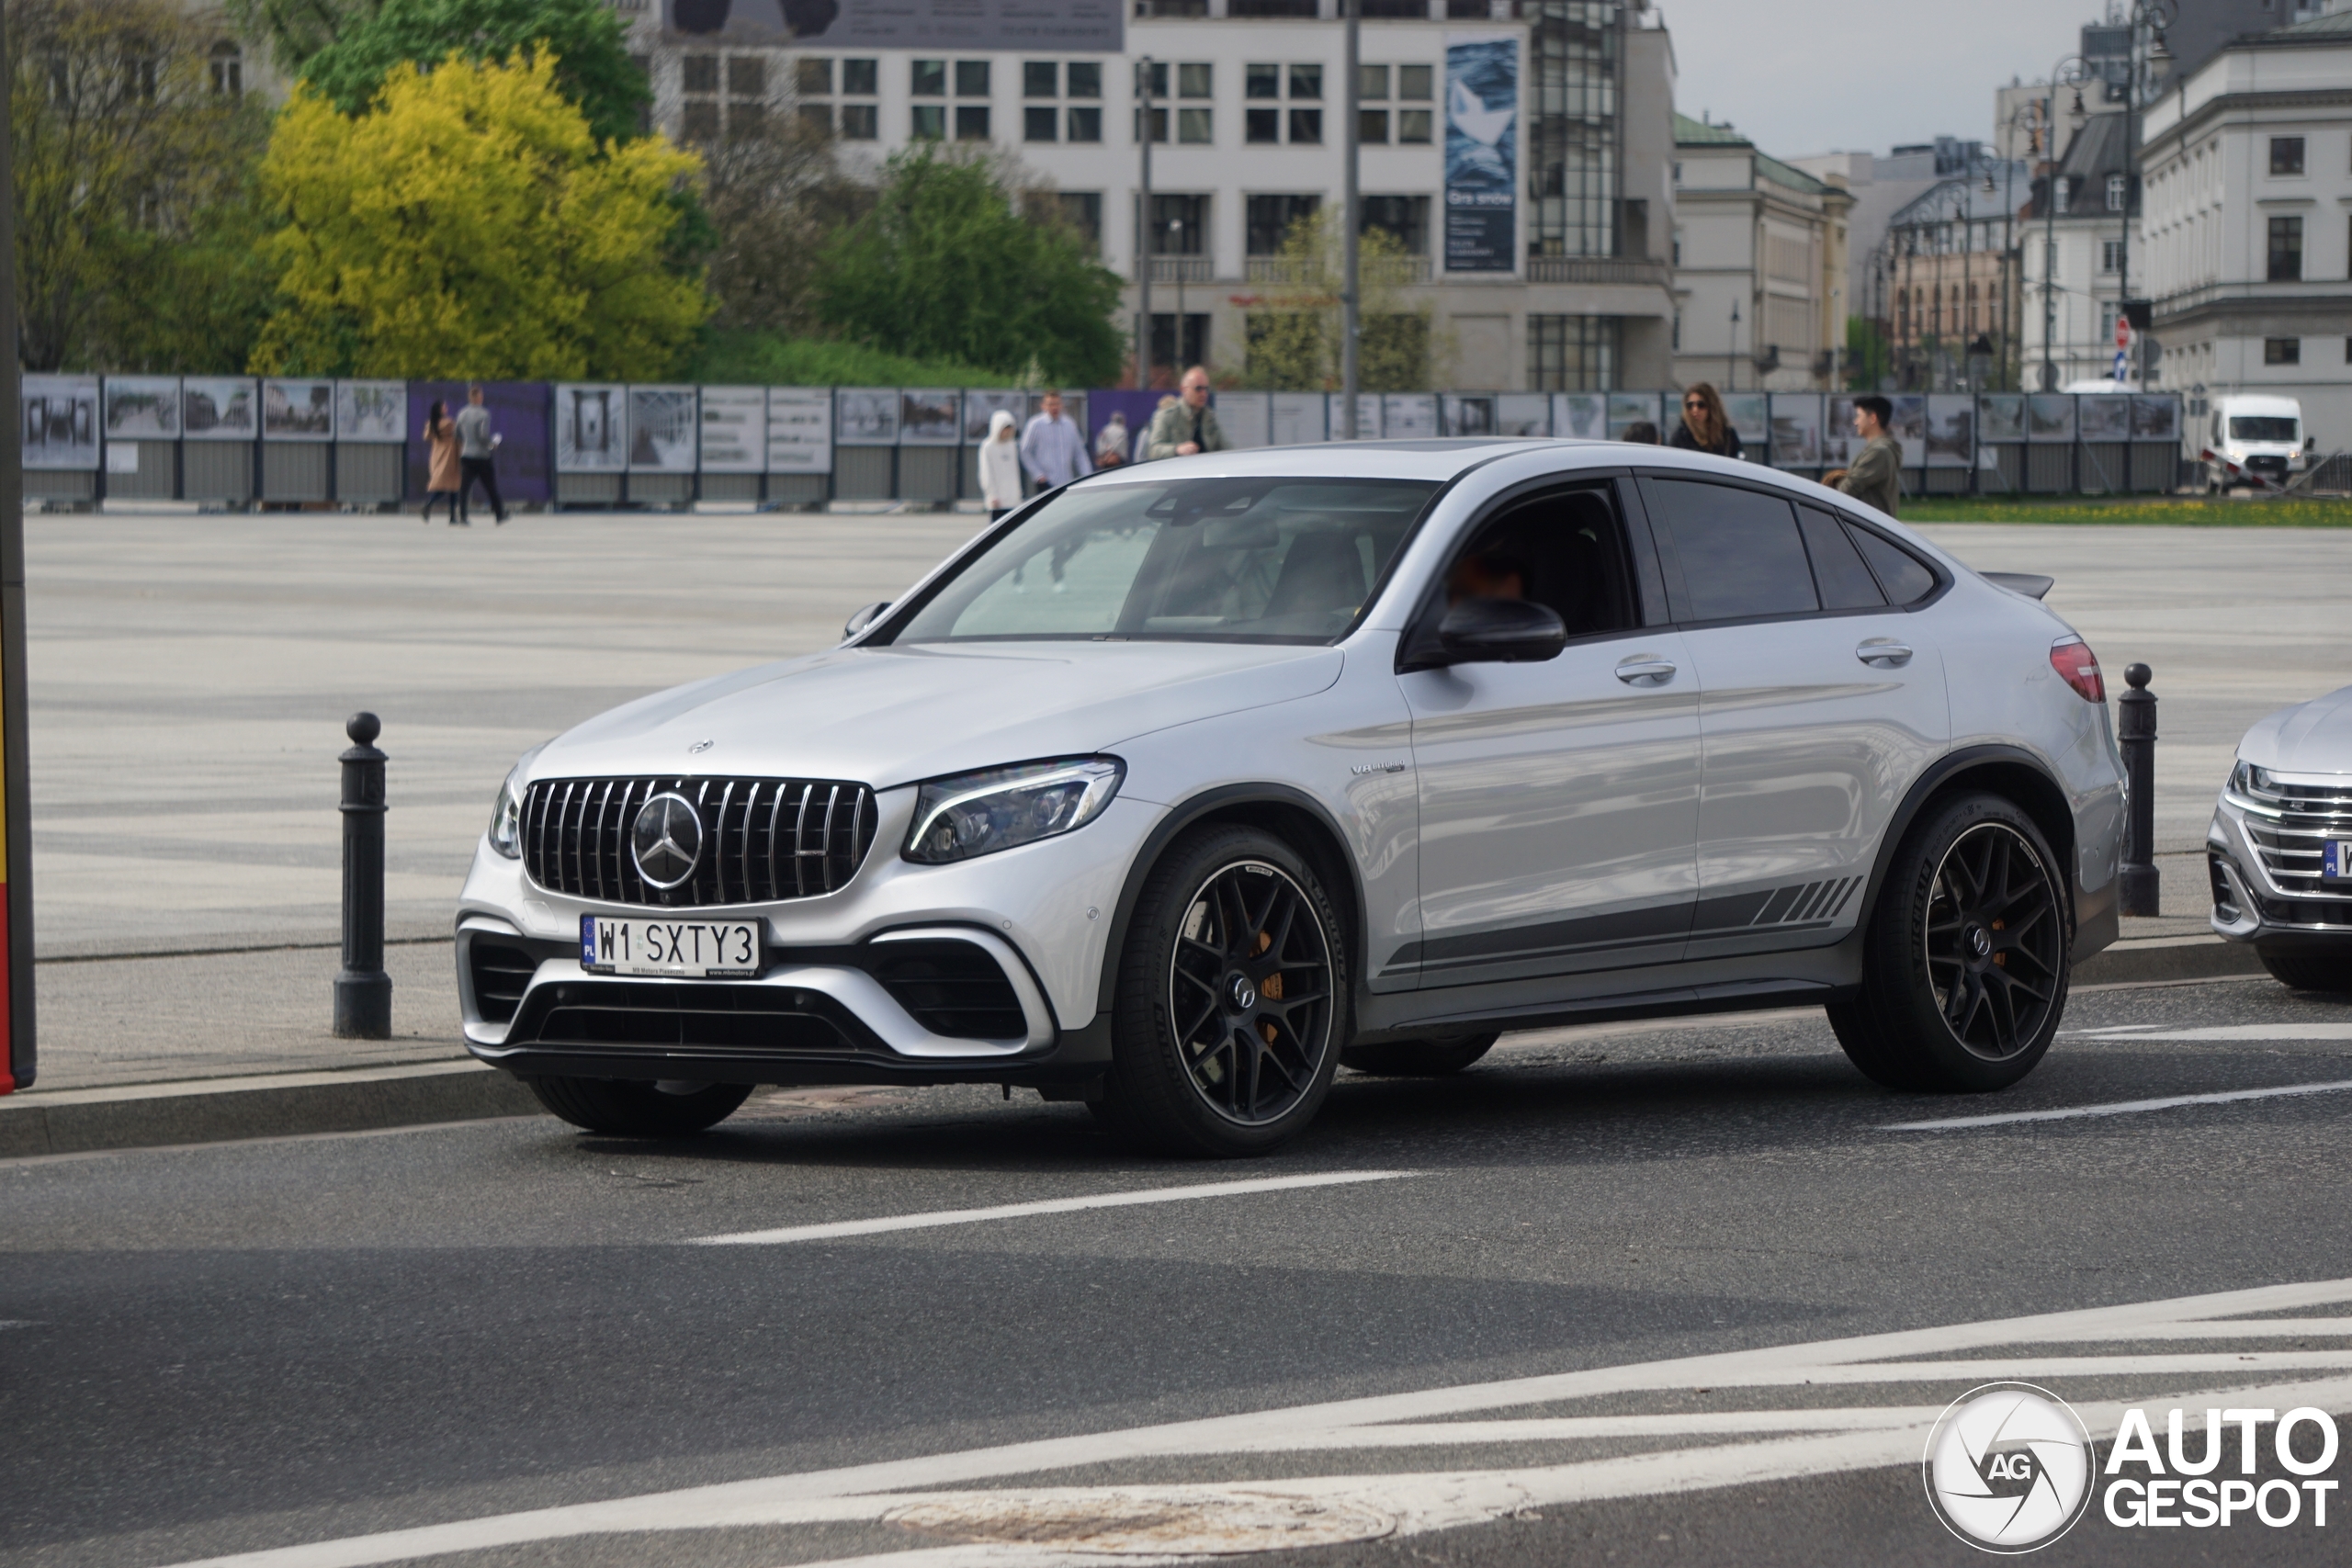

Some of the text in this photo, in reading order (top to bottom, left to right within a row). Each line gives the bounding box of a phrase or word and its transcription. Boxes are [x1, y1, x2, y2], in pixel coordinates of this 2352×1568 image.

[1351, 764, 1372, 775] V8
[1372, 759, 1405, 771] BITURBO
[2325, 863, 2336, 872] PL
[1912, 862, 1932, 961] MICHELIN
[1314, 885, 1347, 976] MICHELIN
[583, 944, 595, 957] PL
[599, 921, 752, 964] W1 SXTY3
[708, 969, 755, 977] www.mbmotors.pl
